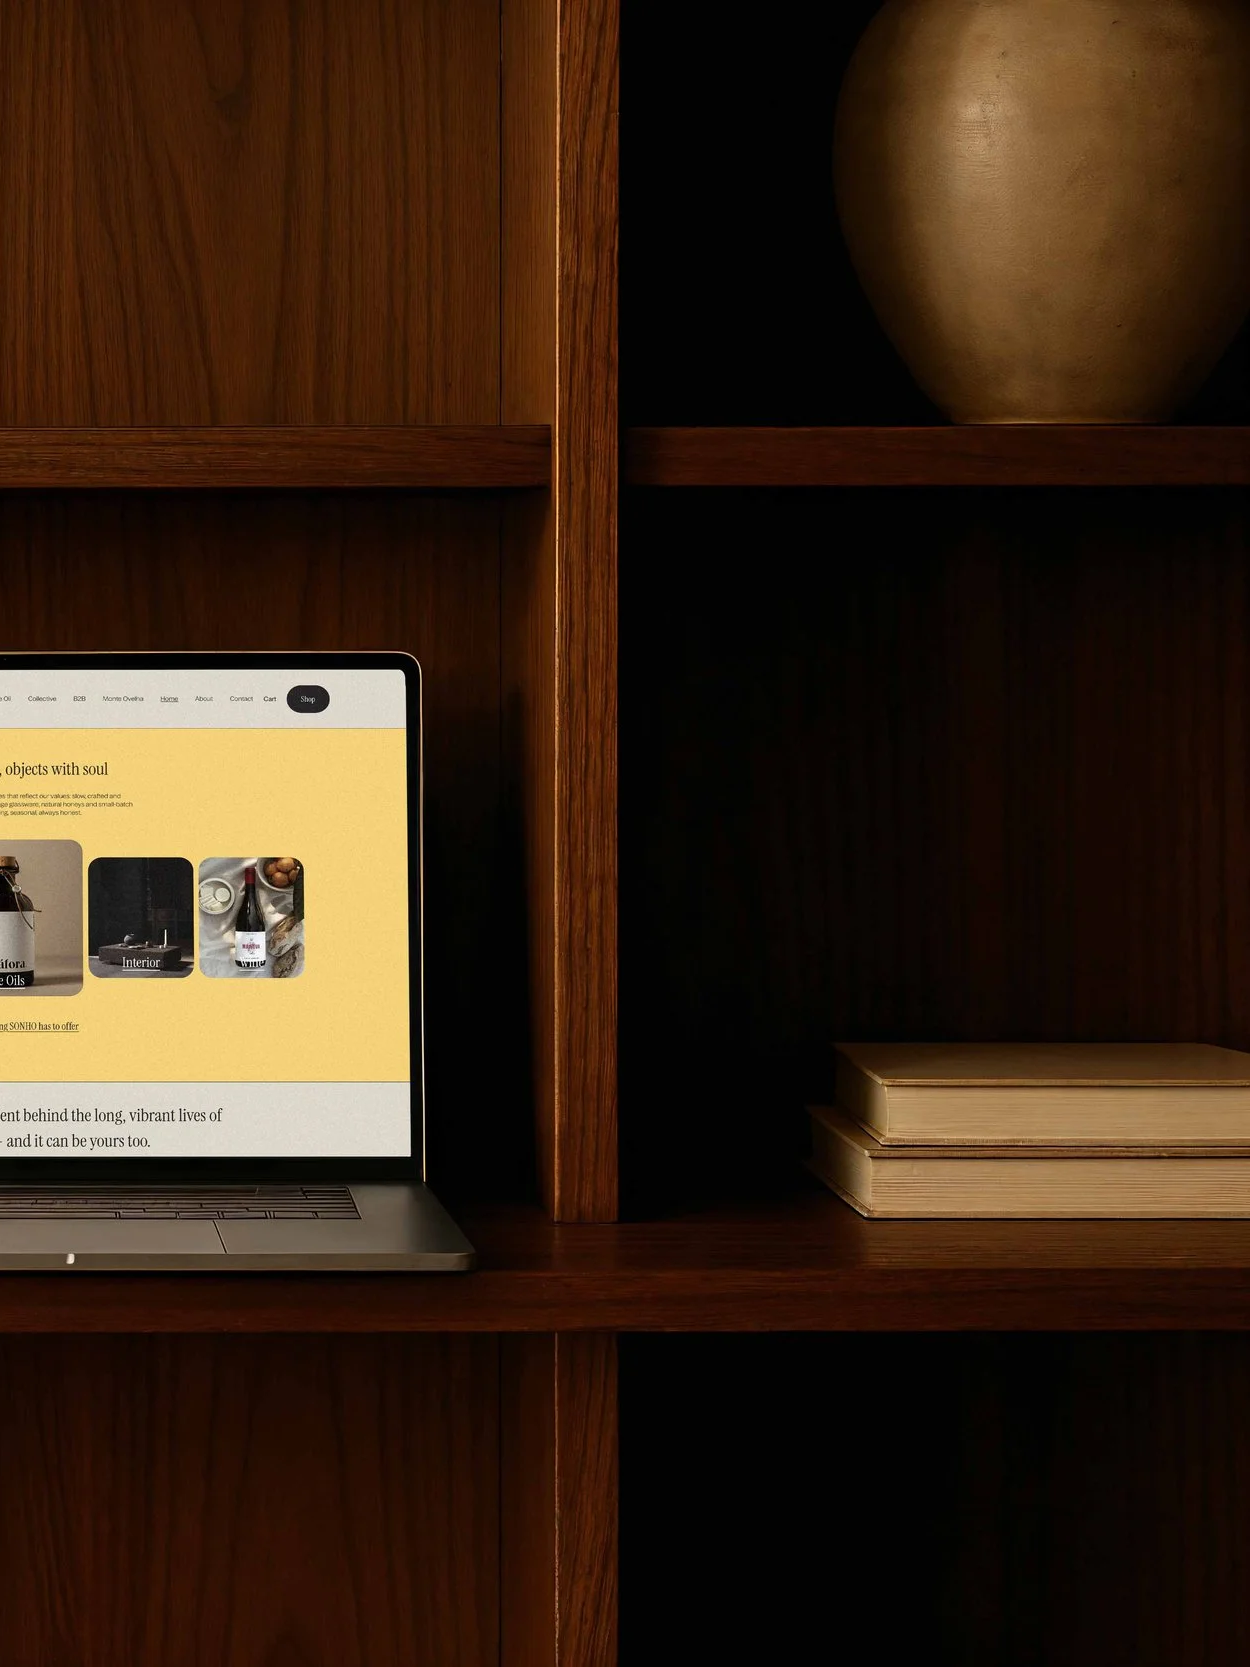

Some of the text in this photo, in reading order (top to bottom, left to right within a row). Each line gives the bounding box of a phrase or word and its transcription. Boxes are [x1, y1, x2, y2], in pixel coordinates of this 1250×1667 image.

[300, 695, 316, 704] Shop
[5, 761, 49, 780] objects
[51, 761, 80, 776] with
[82, 761, 109, 776] soul
[9, 801, 41, 809] glassware,
[62, 801, 85, 809] honeys
[38, 809, 60, 817] always
[122, 956, 161, 969] Interior
[6, 974, 26, 986] Oils
[9, 1021, 37, 1031] SONHO
[38, 1021, 51, 1031] has
[53, 1021, 61, 1031] to
[61, 1021, 80, 1031] offer
[23, 1107, 69, 1123] behind
[71, 1107, 92, 1123] the
[94, 1107, 126, 1126] long,
[129, 1107, 176, 1123] vibrant
[178, 1107, 207, 1123] lives
[209, 1107, 225, 1123] of
[6, 1133, 32, 1148] and
[34, 1133, 44, 1148] it
[46, 1136, 69, 1148] can
[71, 1133, 87, 1148] be
[89, 1136, 125, 1151] yours
[127, 1135, 151, 1148] too.
